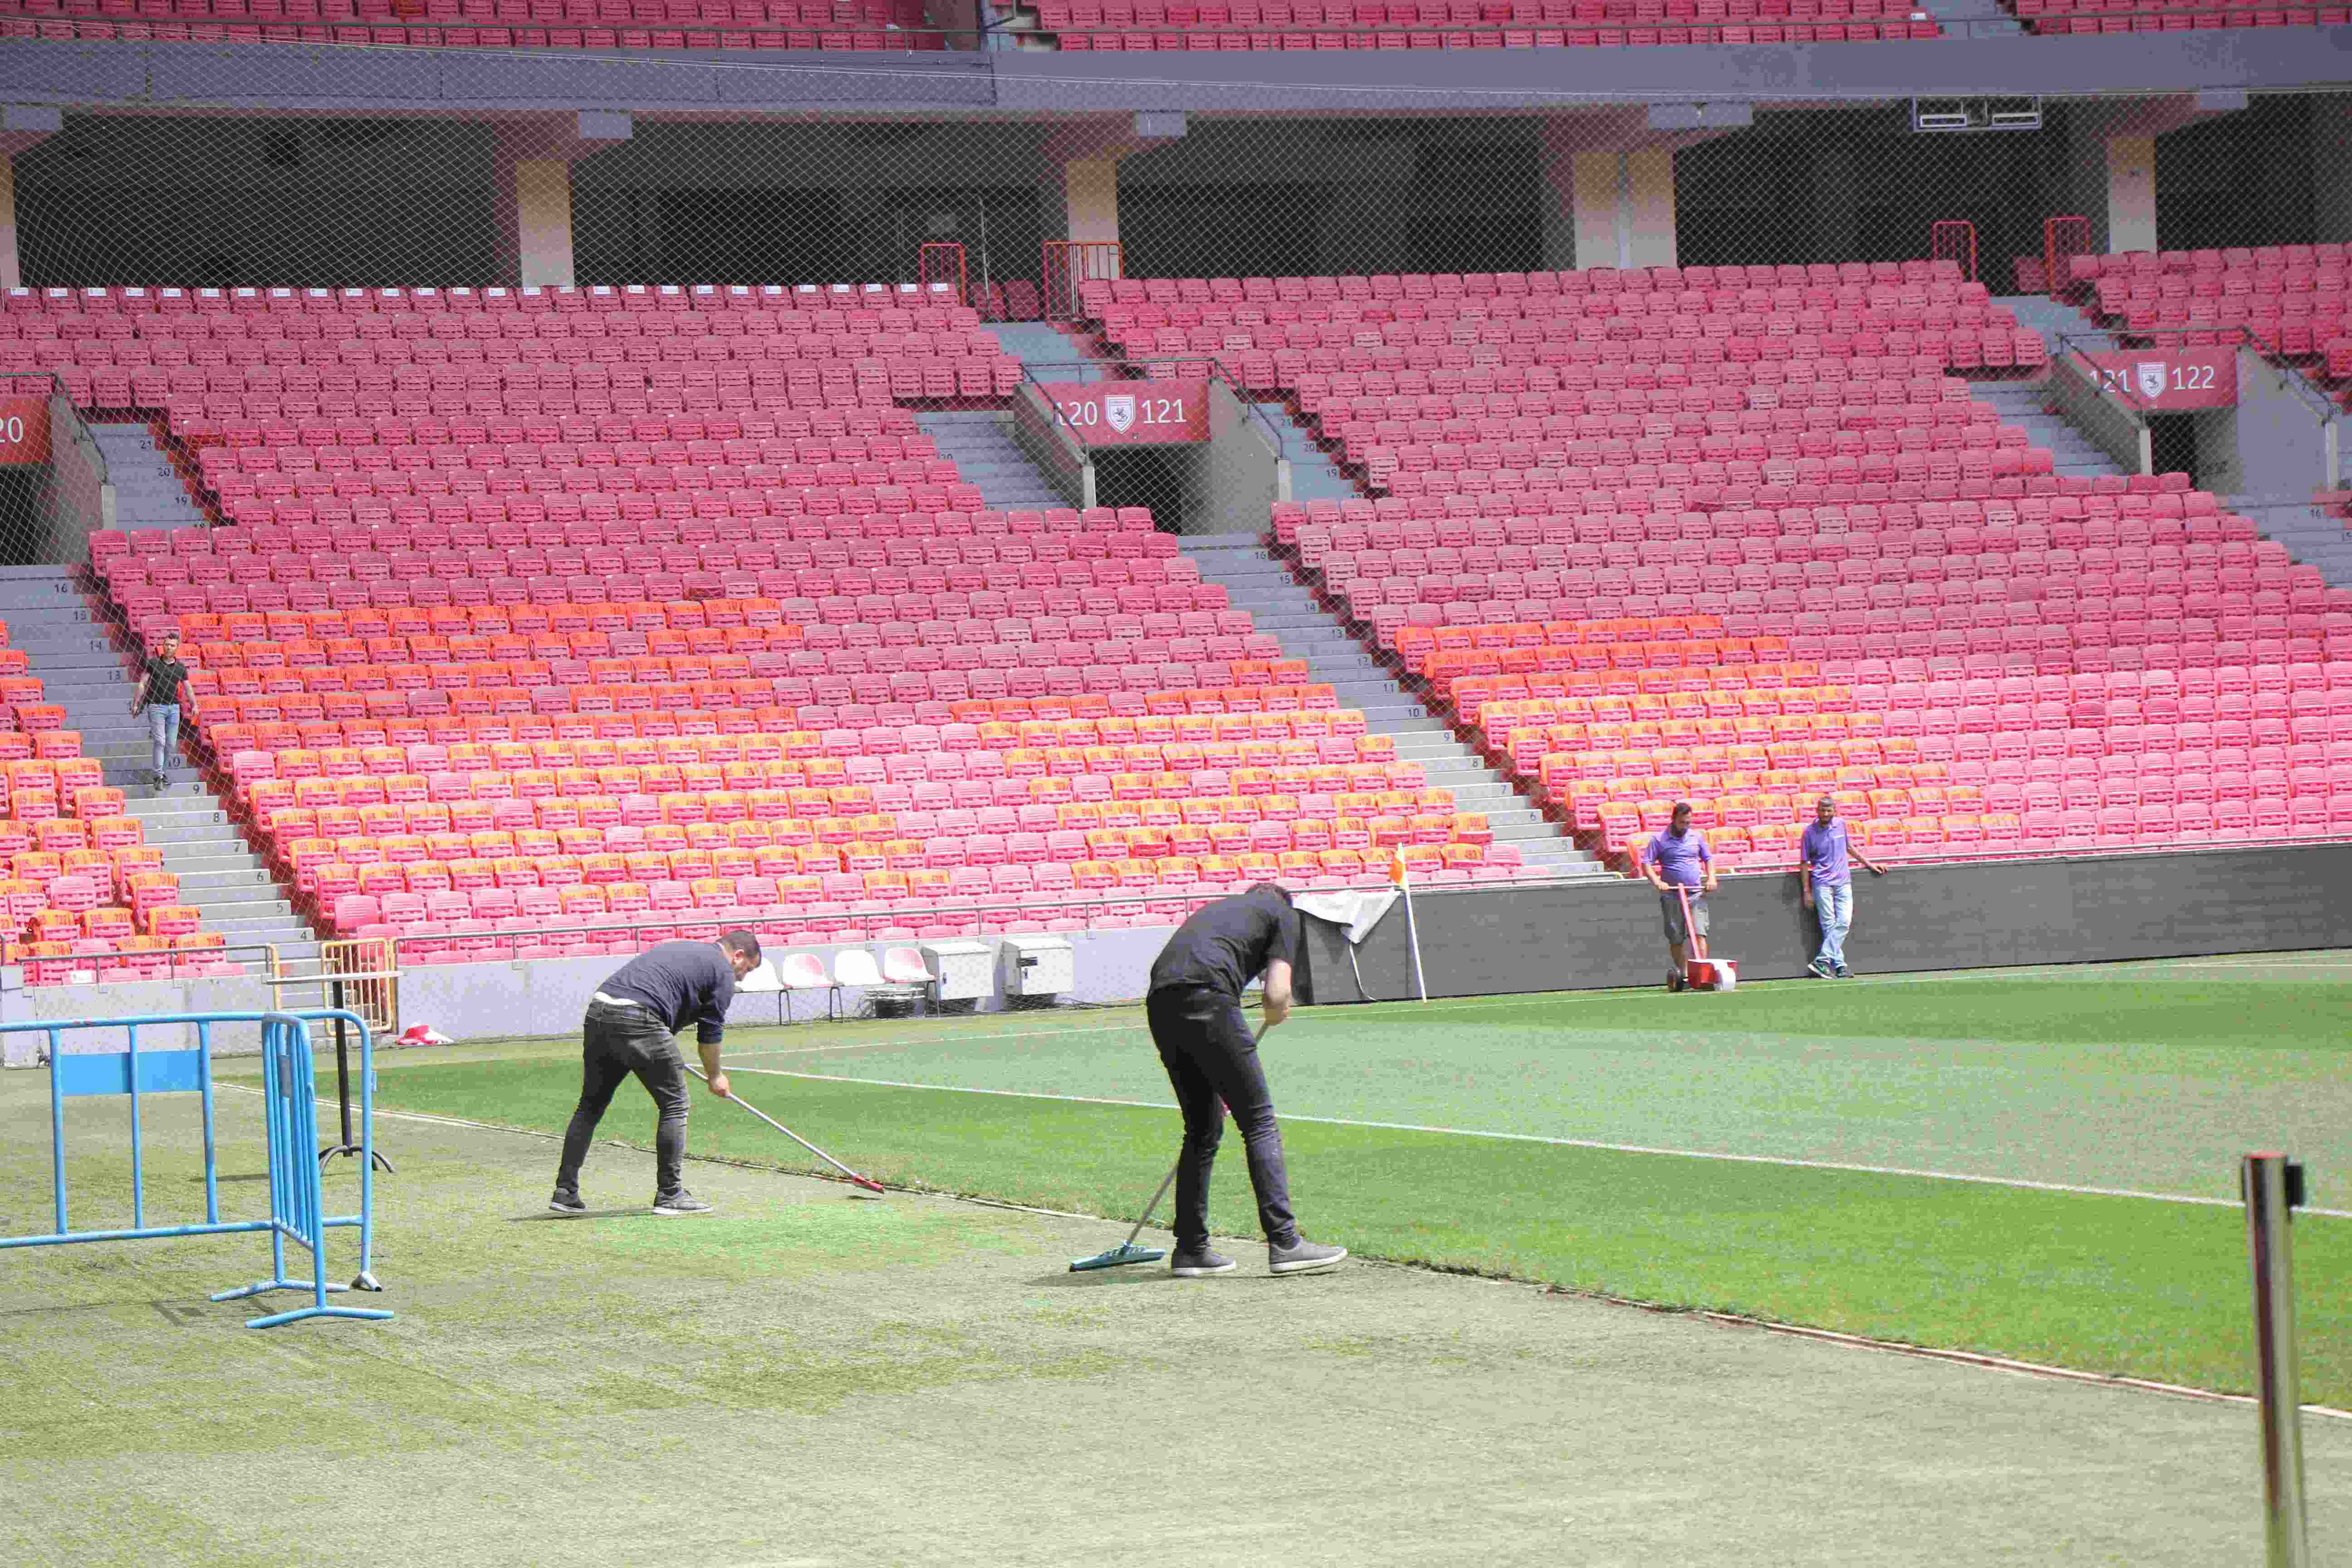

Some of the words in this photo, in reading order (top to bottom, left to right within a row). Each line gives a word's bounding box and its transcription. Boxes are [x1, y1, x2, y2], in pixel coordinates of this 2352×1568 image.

[2171, 366, 2215, 390] 122
[1056, 401, 1098, 426] 120
[1142, 399, 1187, 424] 121
[1383, 684, 1394, 693] 11
[1408, 709, 1419, 717] 10
[1445, 733, 1450, 741] 9
[1472, 758, 1478, 768] 8
[193, 784, 200, 794] 9
[1501, 784, 1507, 795] 7
[214, 813, 220, 823] 8
[1530, 812, 1536, 821] 6
[233, 843, 240, 852] 7
[257, 872, 264, 882] 6
[277, 904, 283, 913] 5
[300, 931, 307, 940] 4
